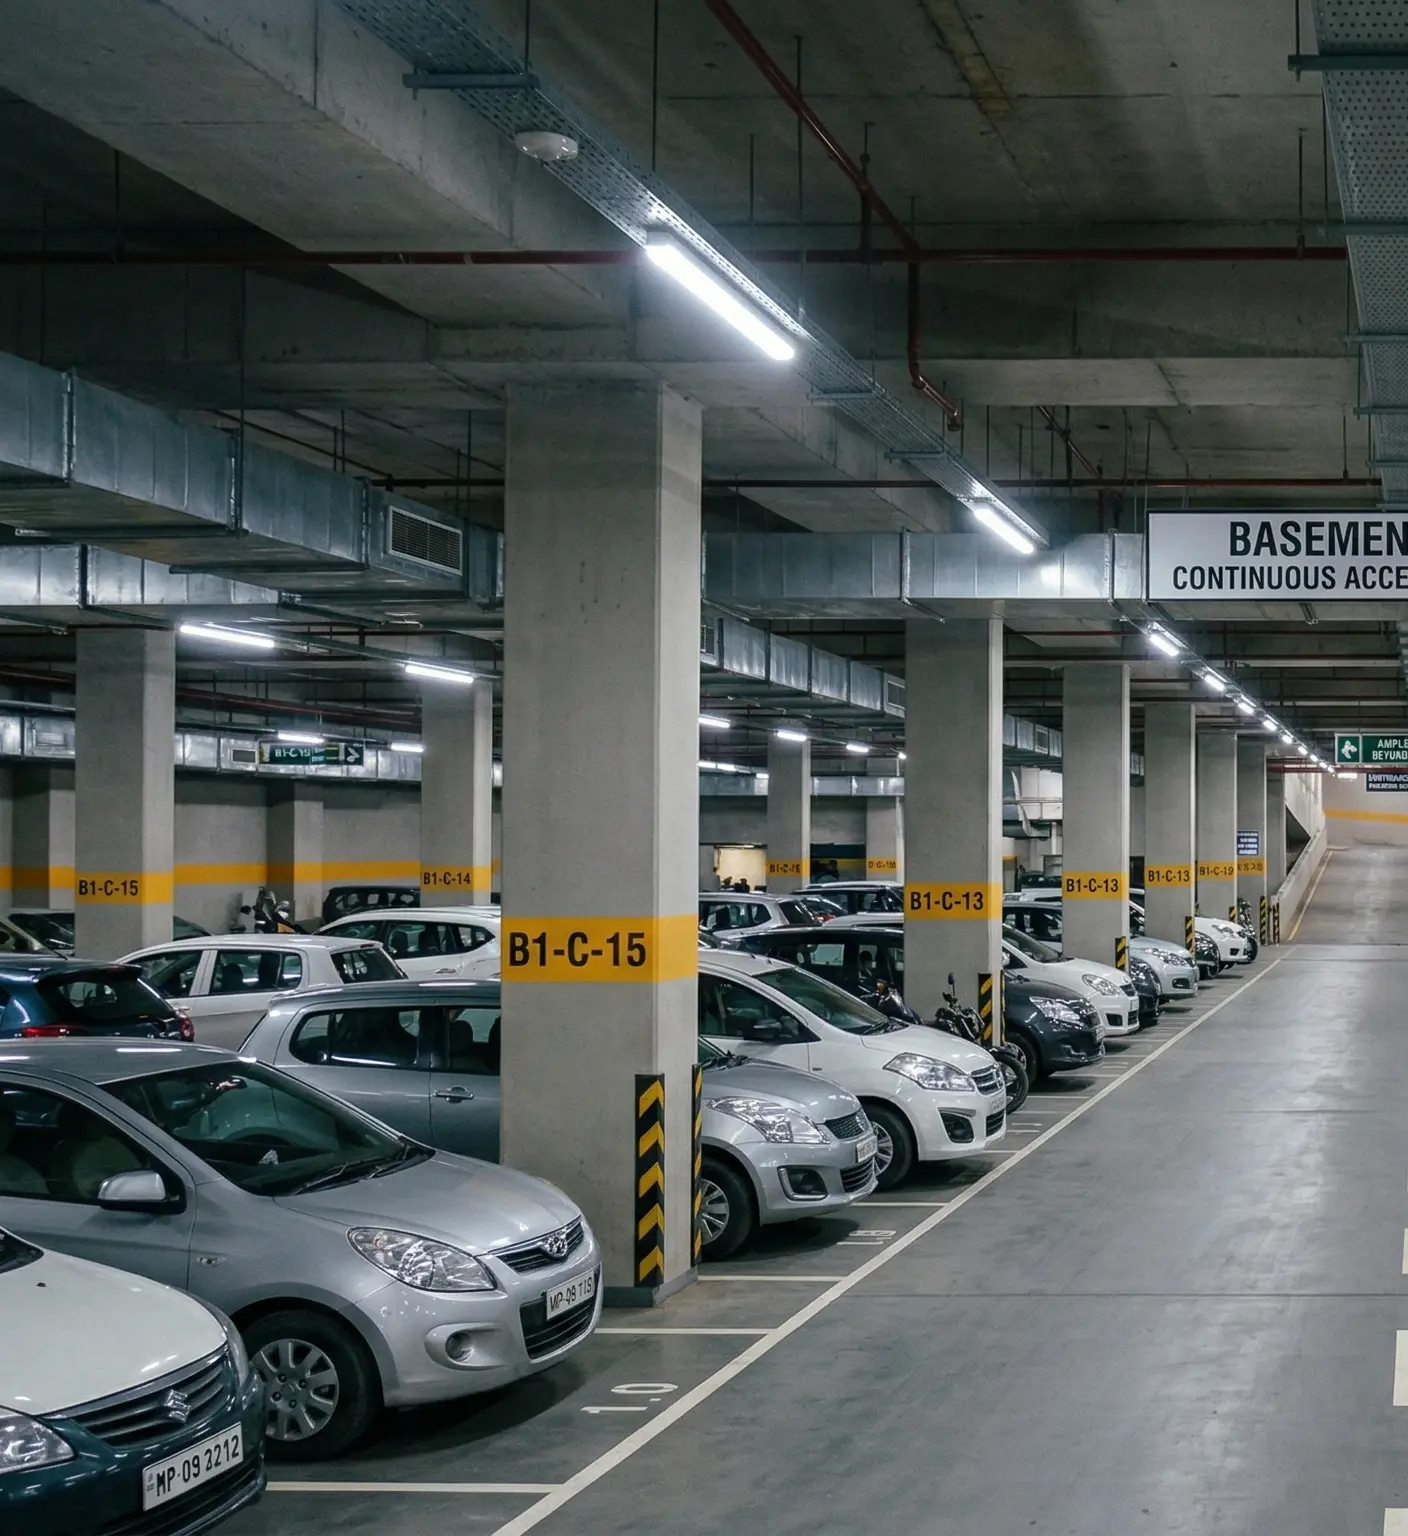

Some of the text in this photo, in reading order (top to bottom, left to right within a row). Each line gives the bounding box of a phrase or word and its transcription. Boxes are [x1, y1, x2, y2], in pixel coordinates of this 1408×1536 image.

[1173, 565, 1336, 590] CONTINUOUS
[1377, 739, 1408, 749] AMPLE
[423, 872, 471, 886] B1-C-14
[1147, 869, 1190, 882] B1-C-13
[78, 880, 139, 896] B1-C-15
[1066, 878, 1119, 892] B1-C-13
[910, 891, 983, 911] B1-C-13
[508, 932, 646, 967] B1-C-15
